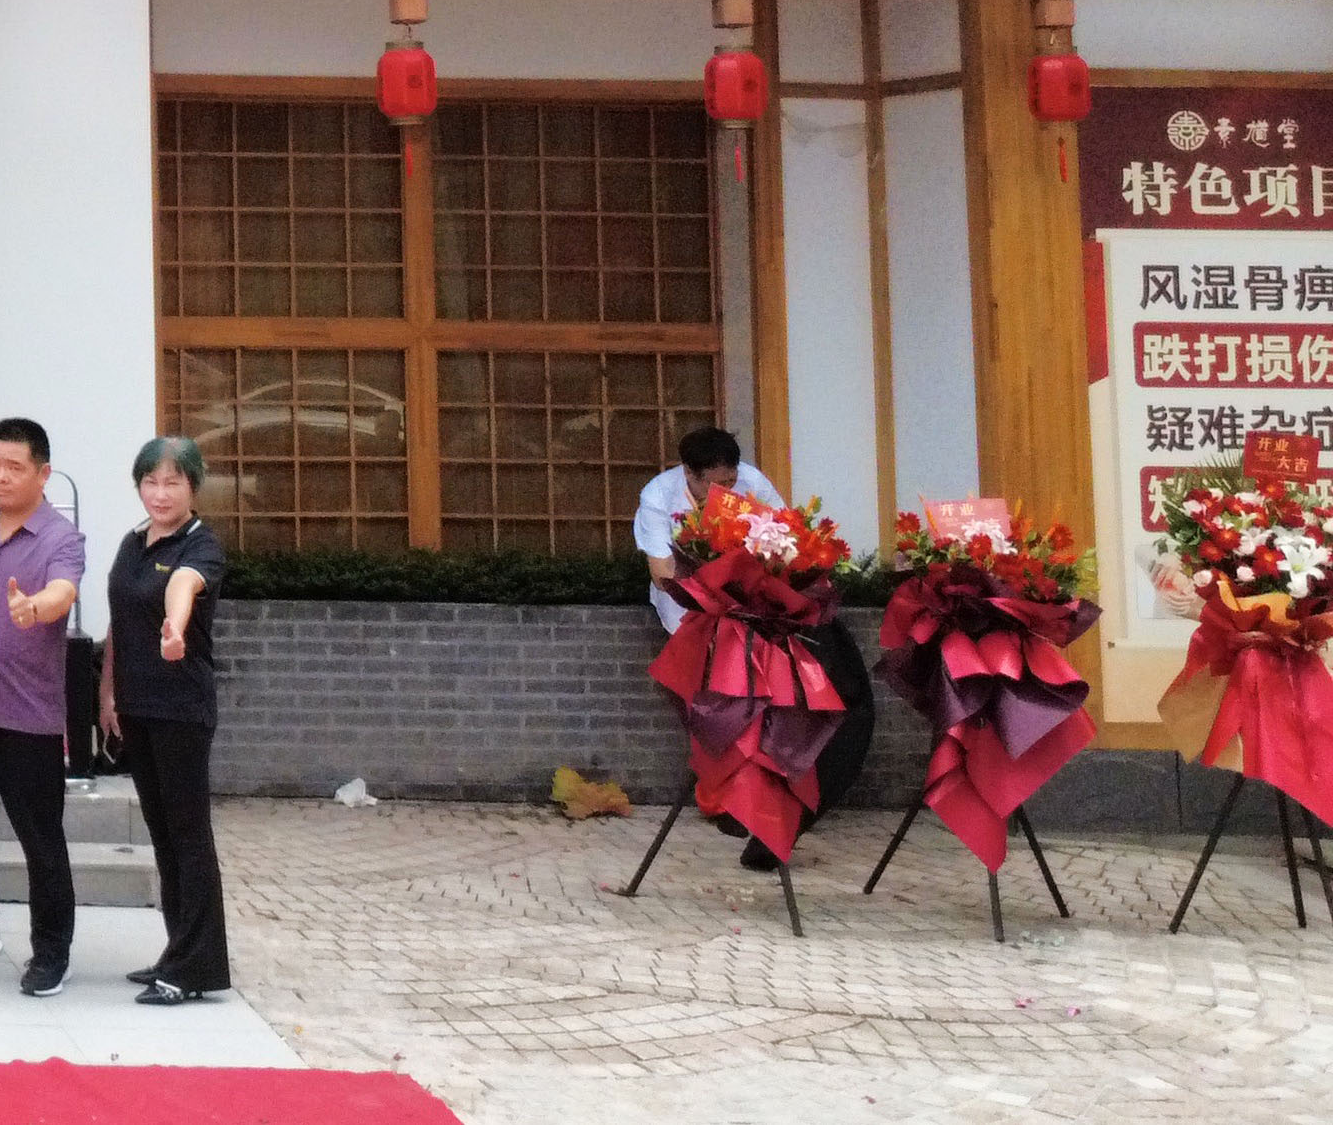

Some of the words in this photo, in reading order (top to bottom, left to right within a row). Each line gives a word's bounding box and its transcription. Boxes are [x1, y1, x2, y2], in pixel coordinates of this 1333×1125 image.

[1213, 117, 1300, 149] 素馗堂
[1140, 264, 1333, 313] 风湿骨痹
[1142, 333, 1333, 384] 跌打损伤
[1277, 456, 1309, 472] 大吉
